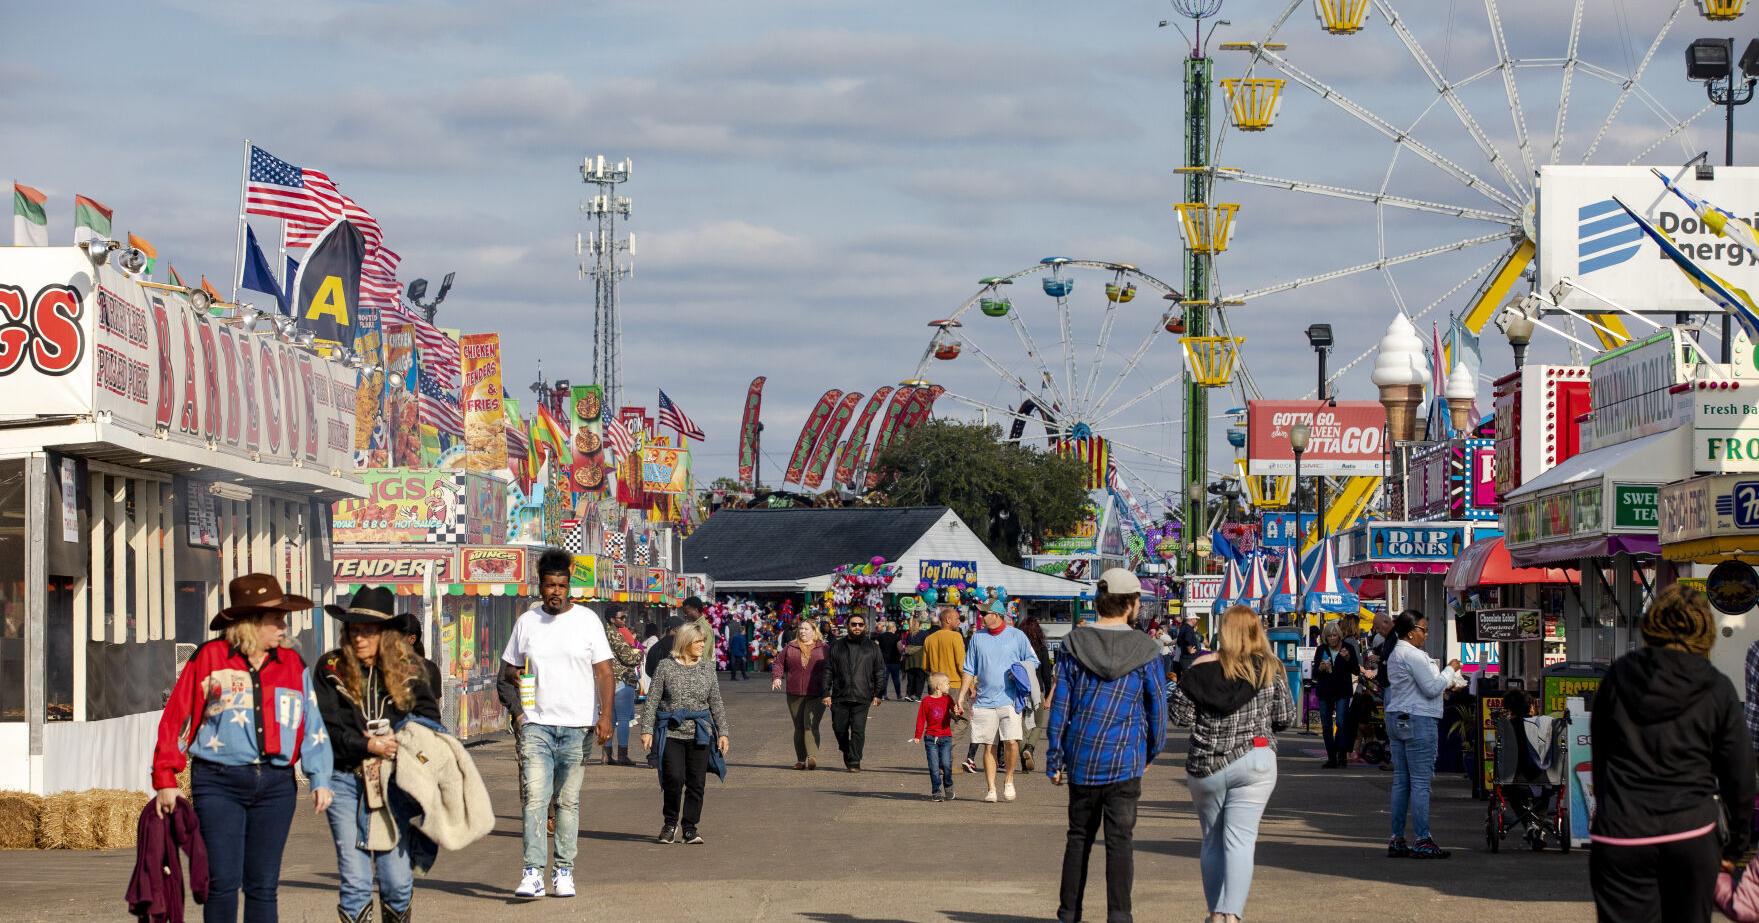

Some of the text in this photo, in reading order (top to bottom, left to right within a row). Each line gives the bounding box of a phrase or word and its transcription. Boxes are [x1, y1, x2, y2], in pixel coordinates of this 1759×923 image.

[463, 343, 497, 359] CHICKEN
[465, 361, 497, 387] TENDERS
[487, 383, 497, 395] &
[1642, 351, 1674, 425] ROLLS
[467, 398, 499, 412] FRIES
[1704, 404, 1737, 414] Fresh
[1272, 412, 1314, 426] GOTTA
[1633, 508, 1658, 521] TEA
[1388, 530, 1448, 543] DIP
[1388, 542, 1448, 555] CONES
[921, 561, 966, 584] Toy Time
[1321, 594, 1342, 605] ENTER
[1559, 681, 1599, 696] FROZE
